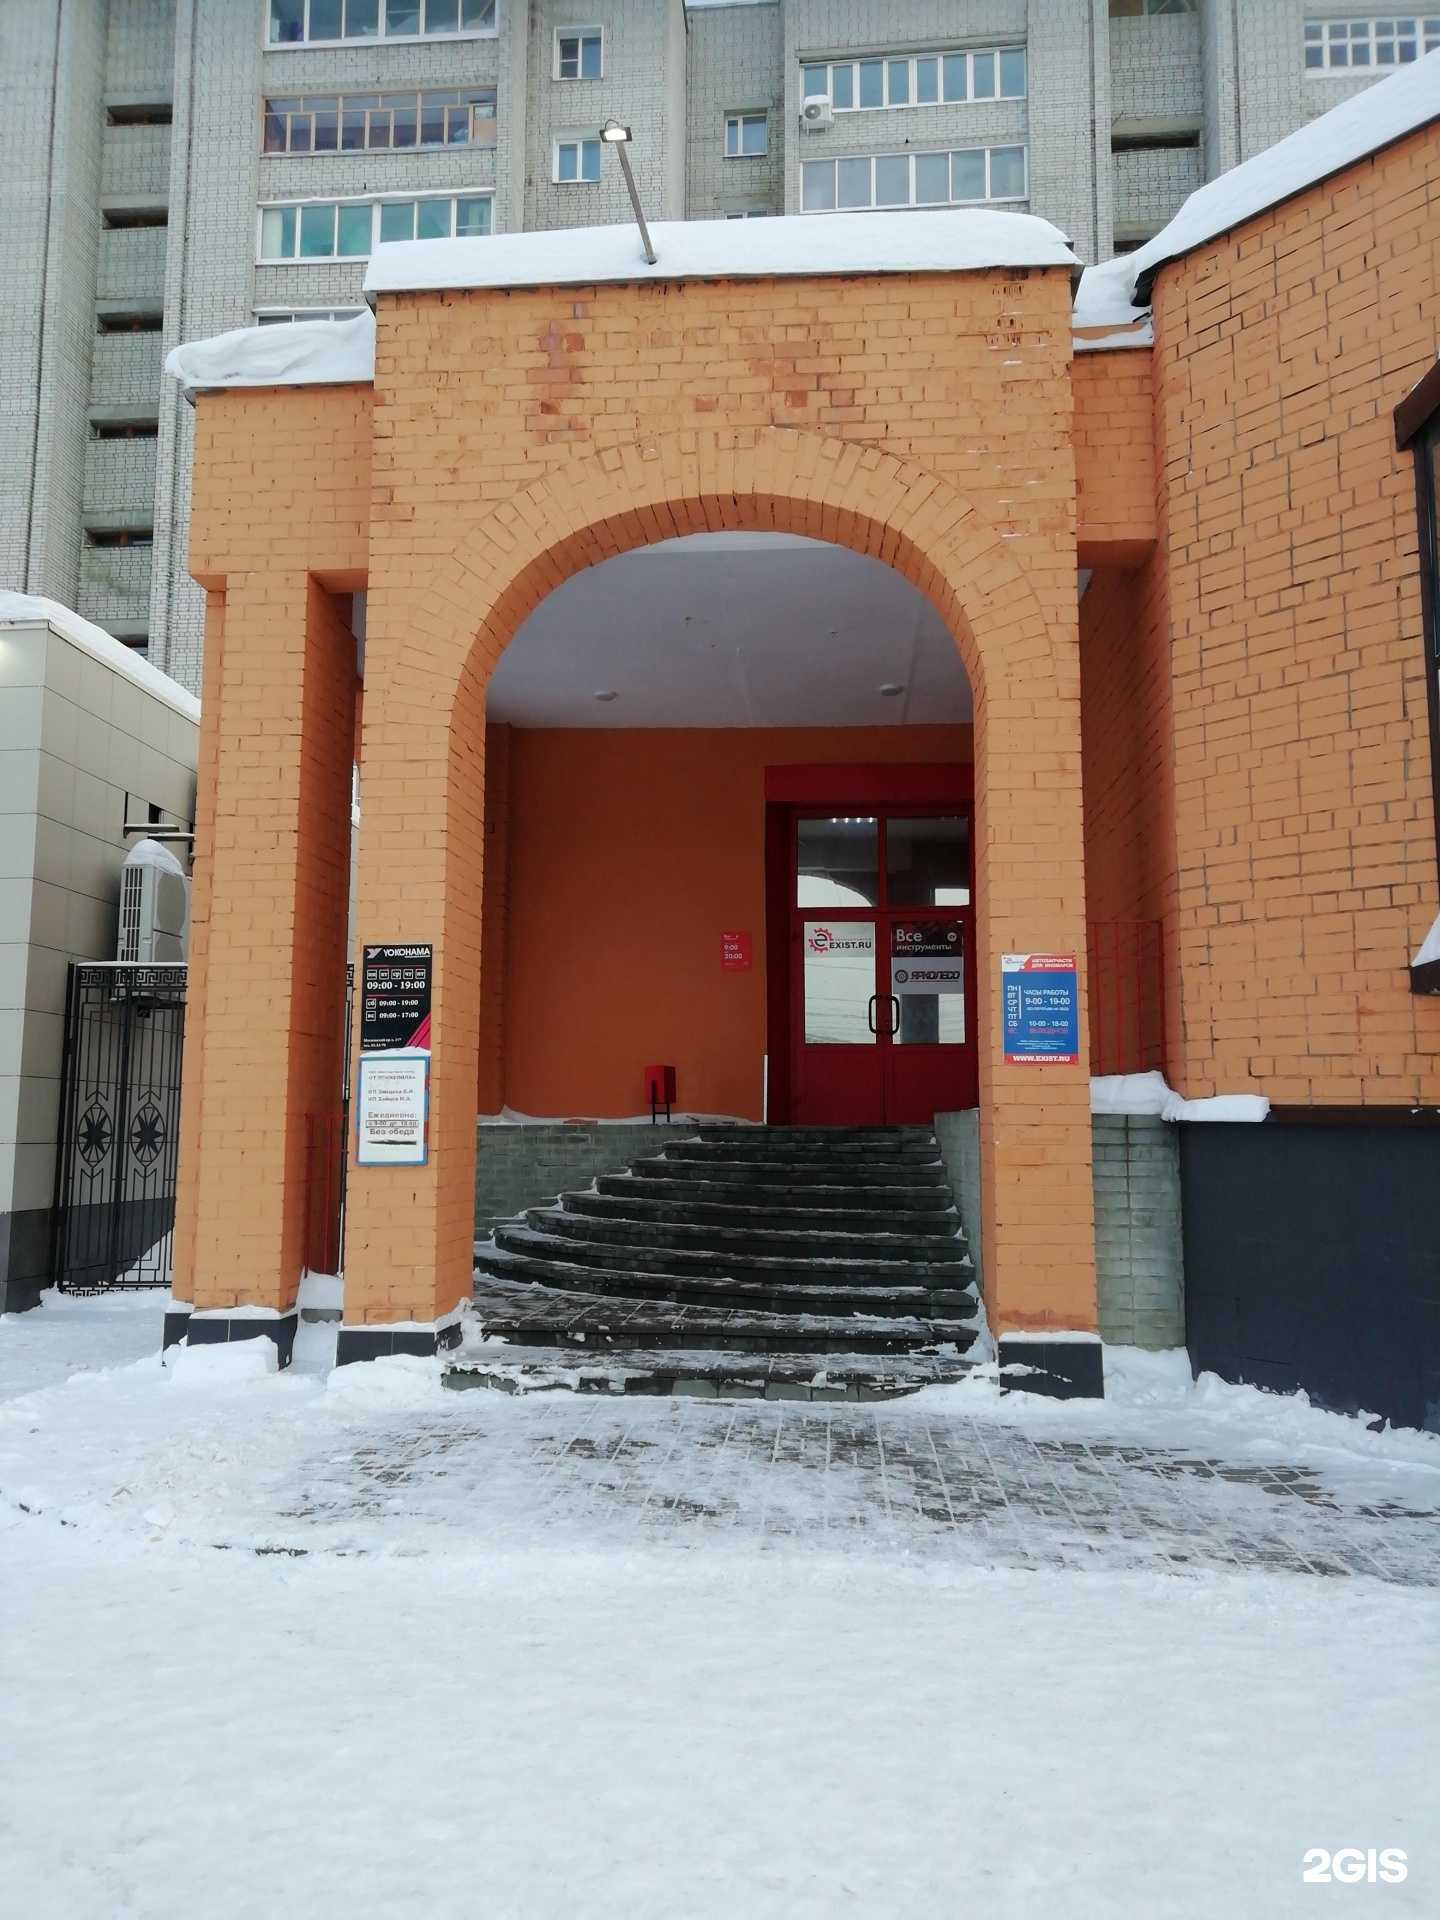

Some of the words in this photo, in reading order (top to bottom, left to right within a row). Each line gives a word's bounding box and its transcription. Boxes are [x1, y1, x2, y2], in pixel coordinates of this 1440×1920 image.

[896, 929, 922, 942] Все
[829, 941, 872, 949] EXIST.RU
[896, 943, 952, 952] инструменты
[383, 947, 431, 957] YOKOHAMA
[367, 981, 393, 990] 09:00
[400, 981, 425, 989] 19:00
[1050, 997, 1070, 1005] 19-00
[1013, 1055, 1071, 1063] WWW.EXIST.RU
[388, 1128, 415, 1136] обеда
